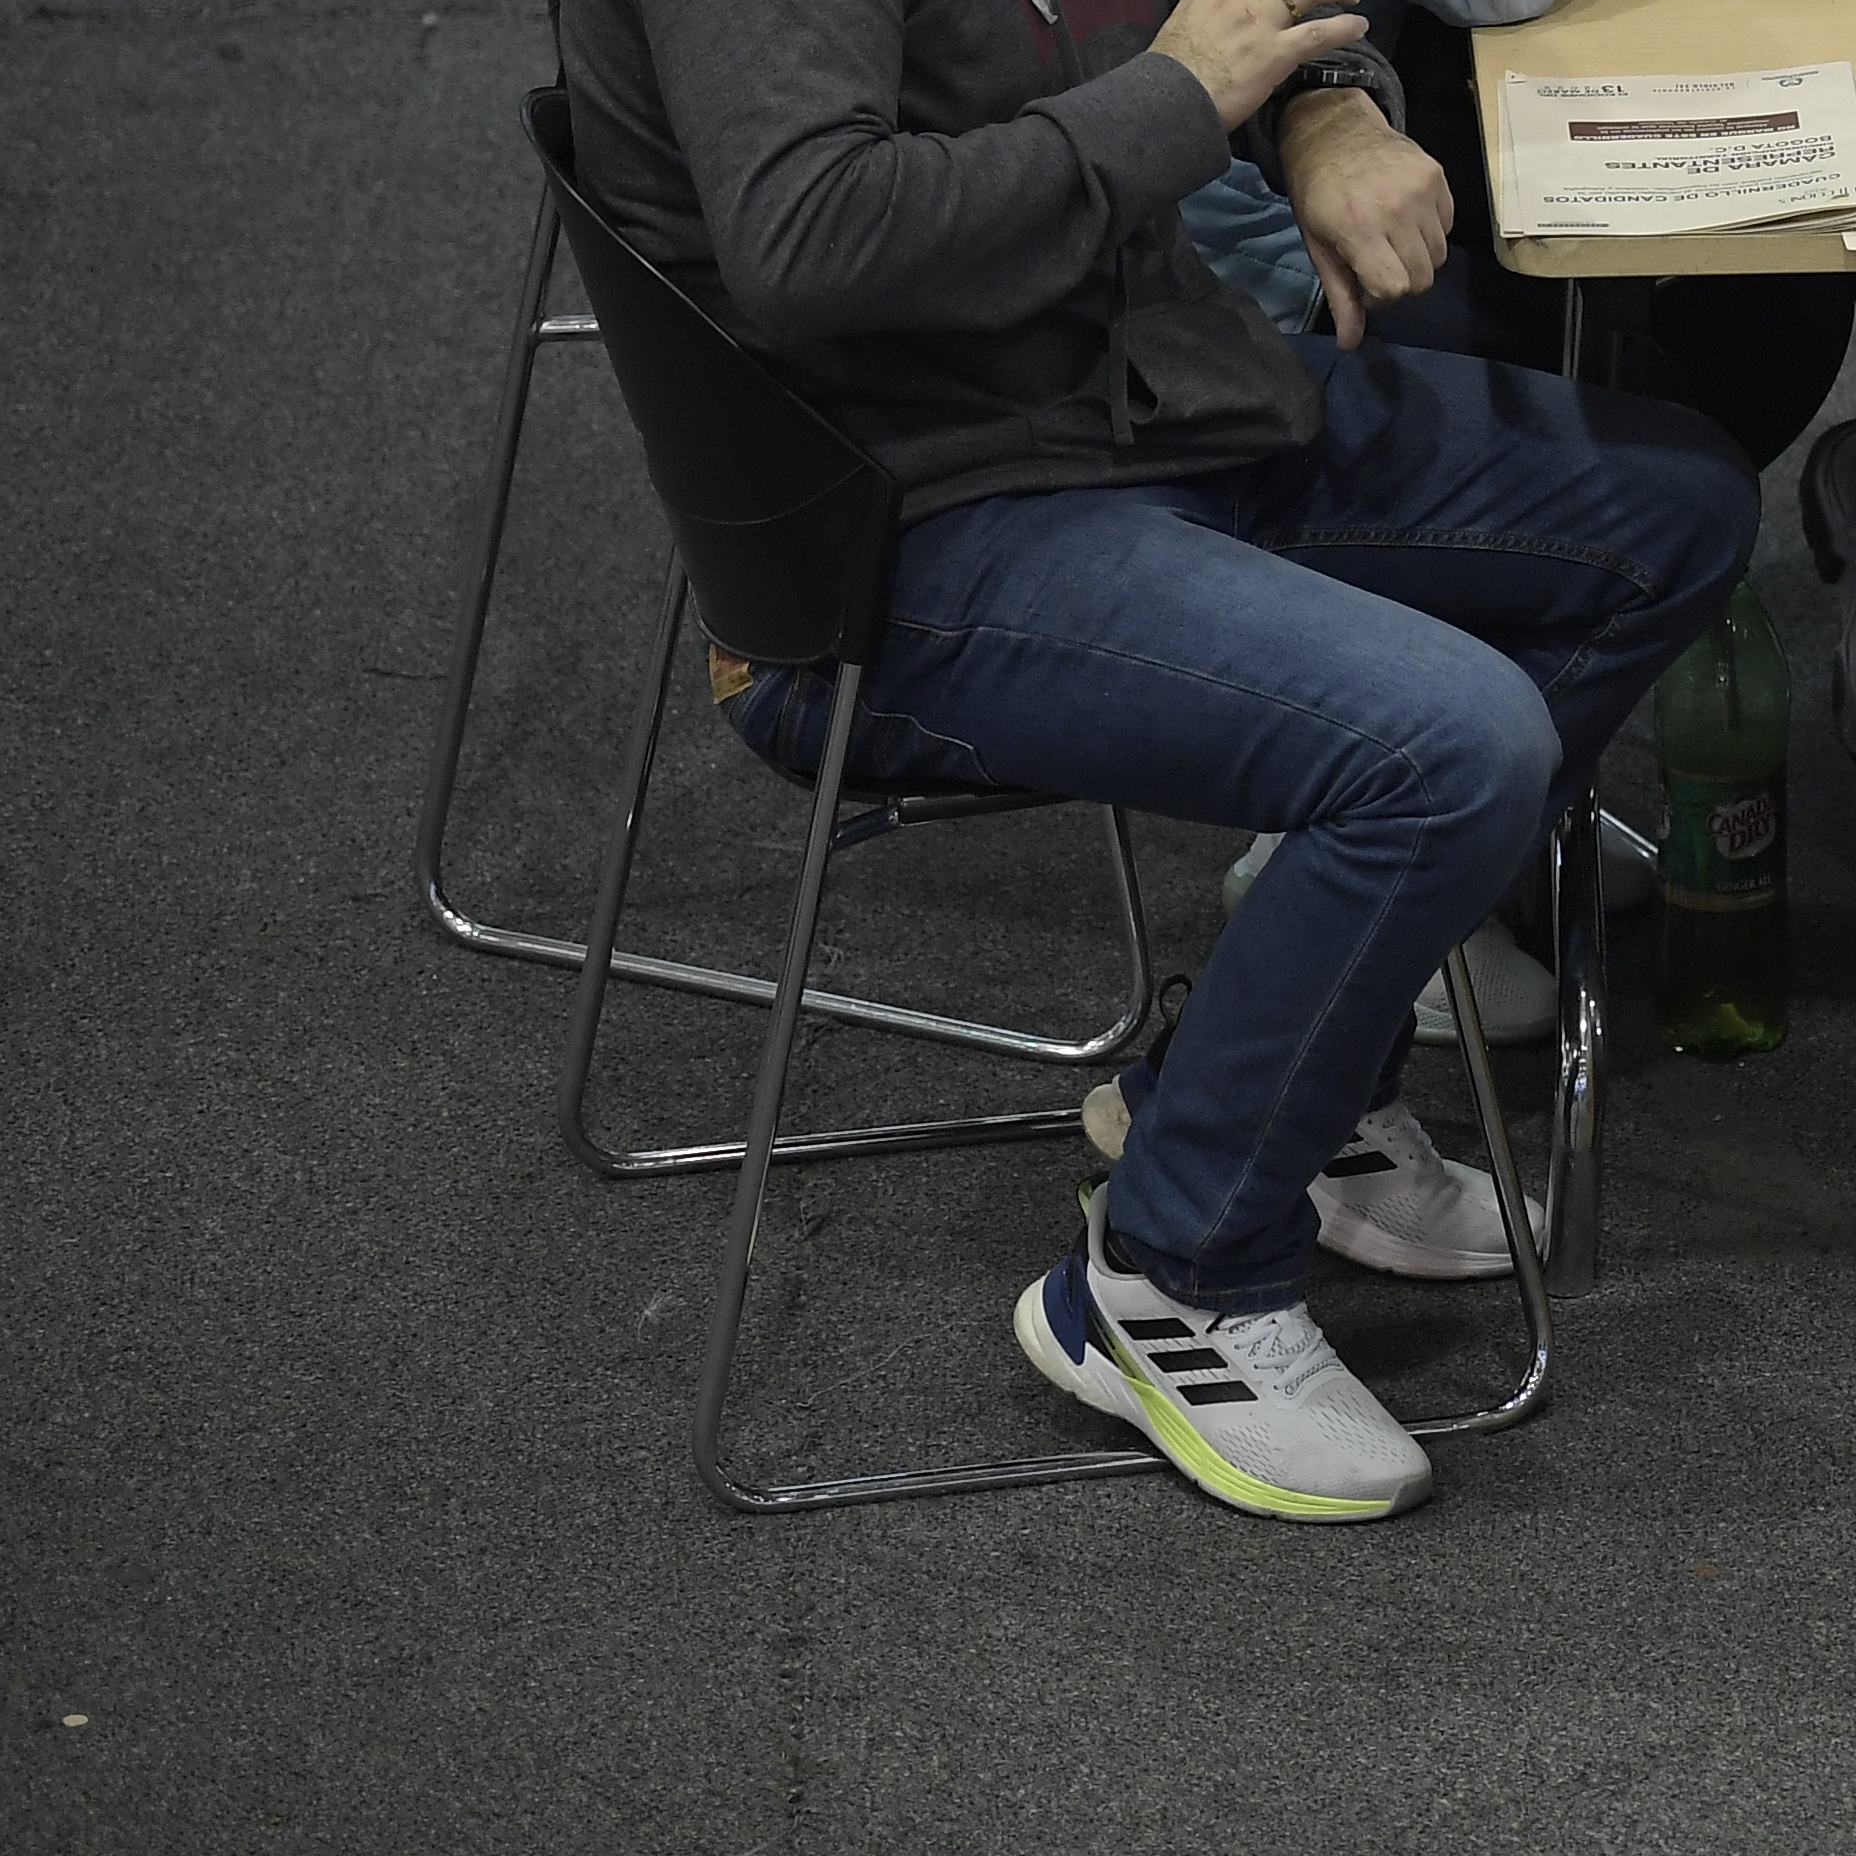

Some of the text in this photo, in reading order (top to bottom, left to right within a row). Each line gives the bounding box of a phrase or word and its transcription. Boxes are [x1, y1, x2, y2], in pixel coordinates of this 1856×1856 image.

[1600, 84, 1623, 93] 13
[1686, 166, 1719, 174] DE
[1541, 172, 1841, 207] CUADERNILLO DE CANDIDATOS
[1706, 795, 1774, 835] CANAD
